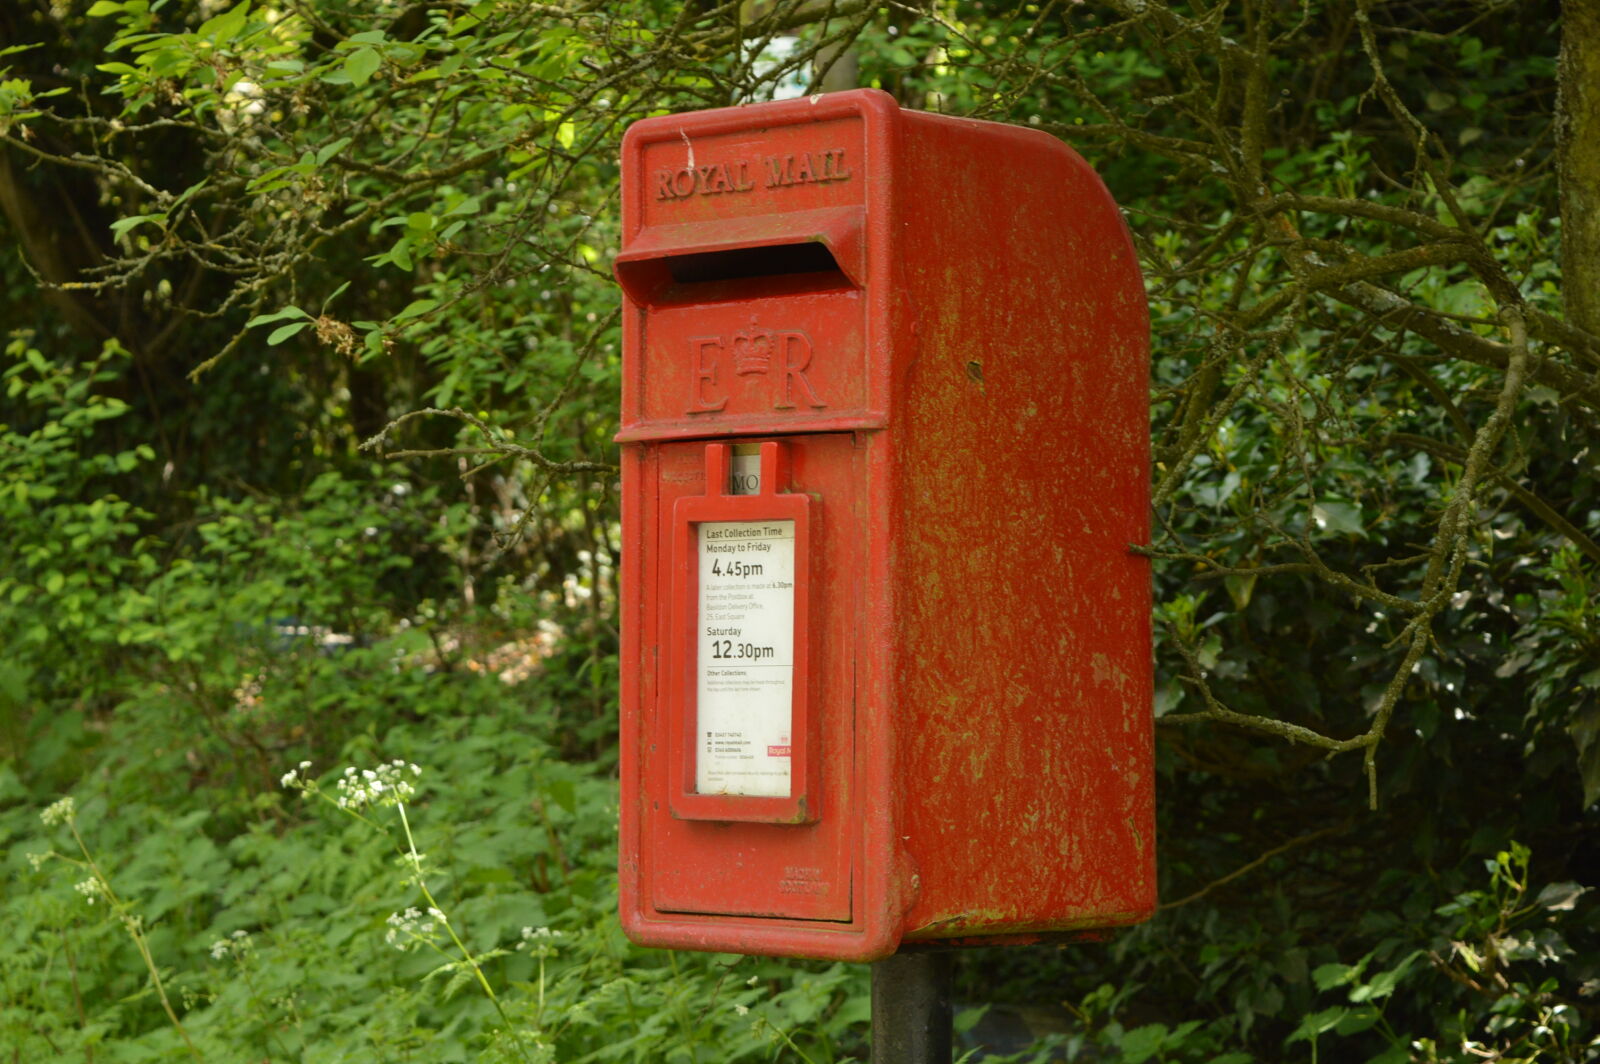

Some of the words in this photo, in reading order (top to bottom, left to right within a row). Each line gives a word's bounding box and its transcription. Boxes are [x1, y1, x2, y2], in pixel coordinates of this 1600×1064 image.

[656, 161, 755, 201] ROYAL
[765, 150, 852, 189] MAIL
[686, 336, 729, 415] E
[774, 330, 828, 410] R
[732, 472, 760, 491] MO
[706, 530, 723, 539] Last
[724, 528, 761, 538] Collection
[763, 526, 782, 536] Time
[706, 544, 736, 554] Monday
[737, 544, 746, 552] to
[747, 542, 771, 552] Friday
[712, 558, 763, 579] 4.45pm
[706, 626, 742, 637] Saturday
[712, 640, 774, 661] 12.30pm
